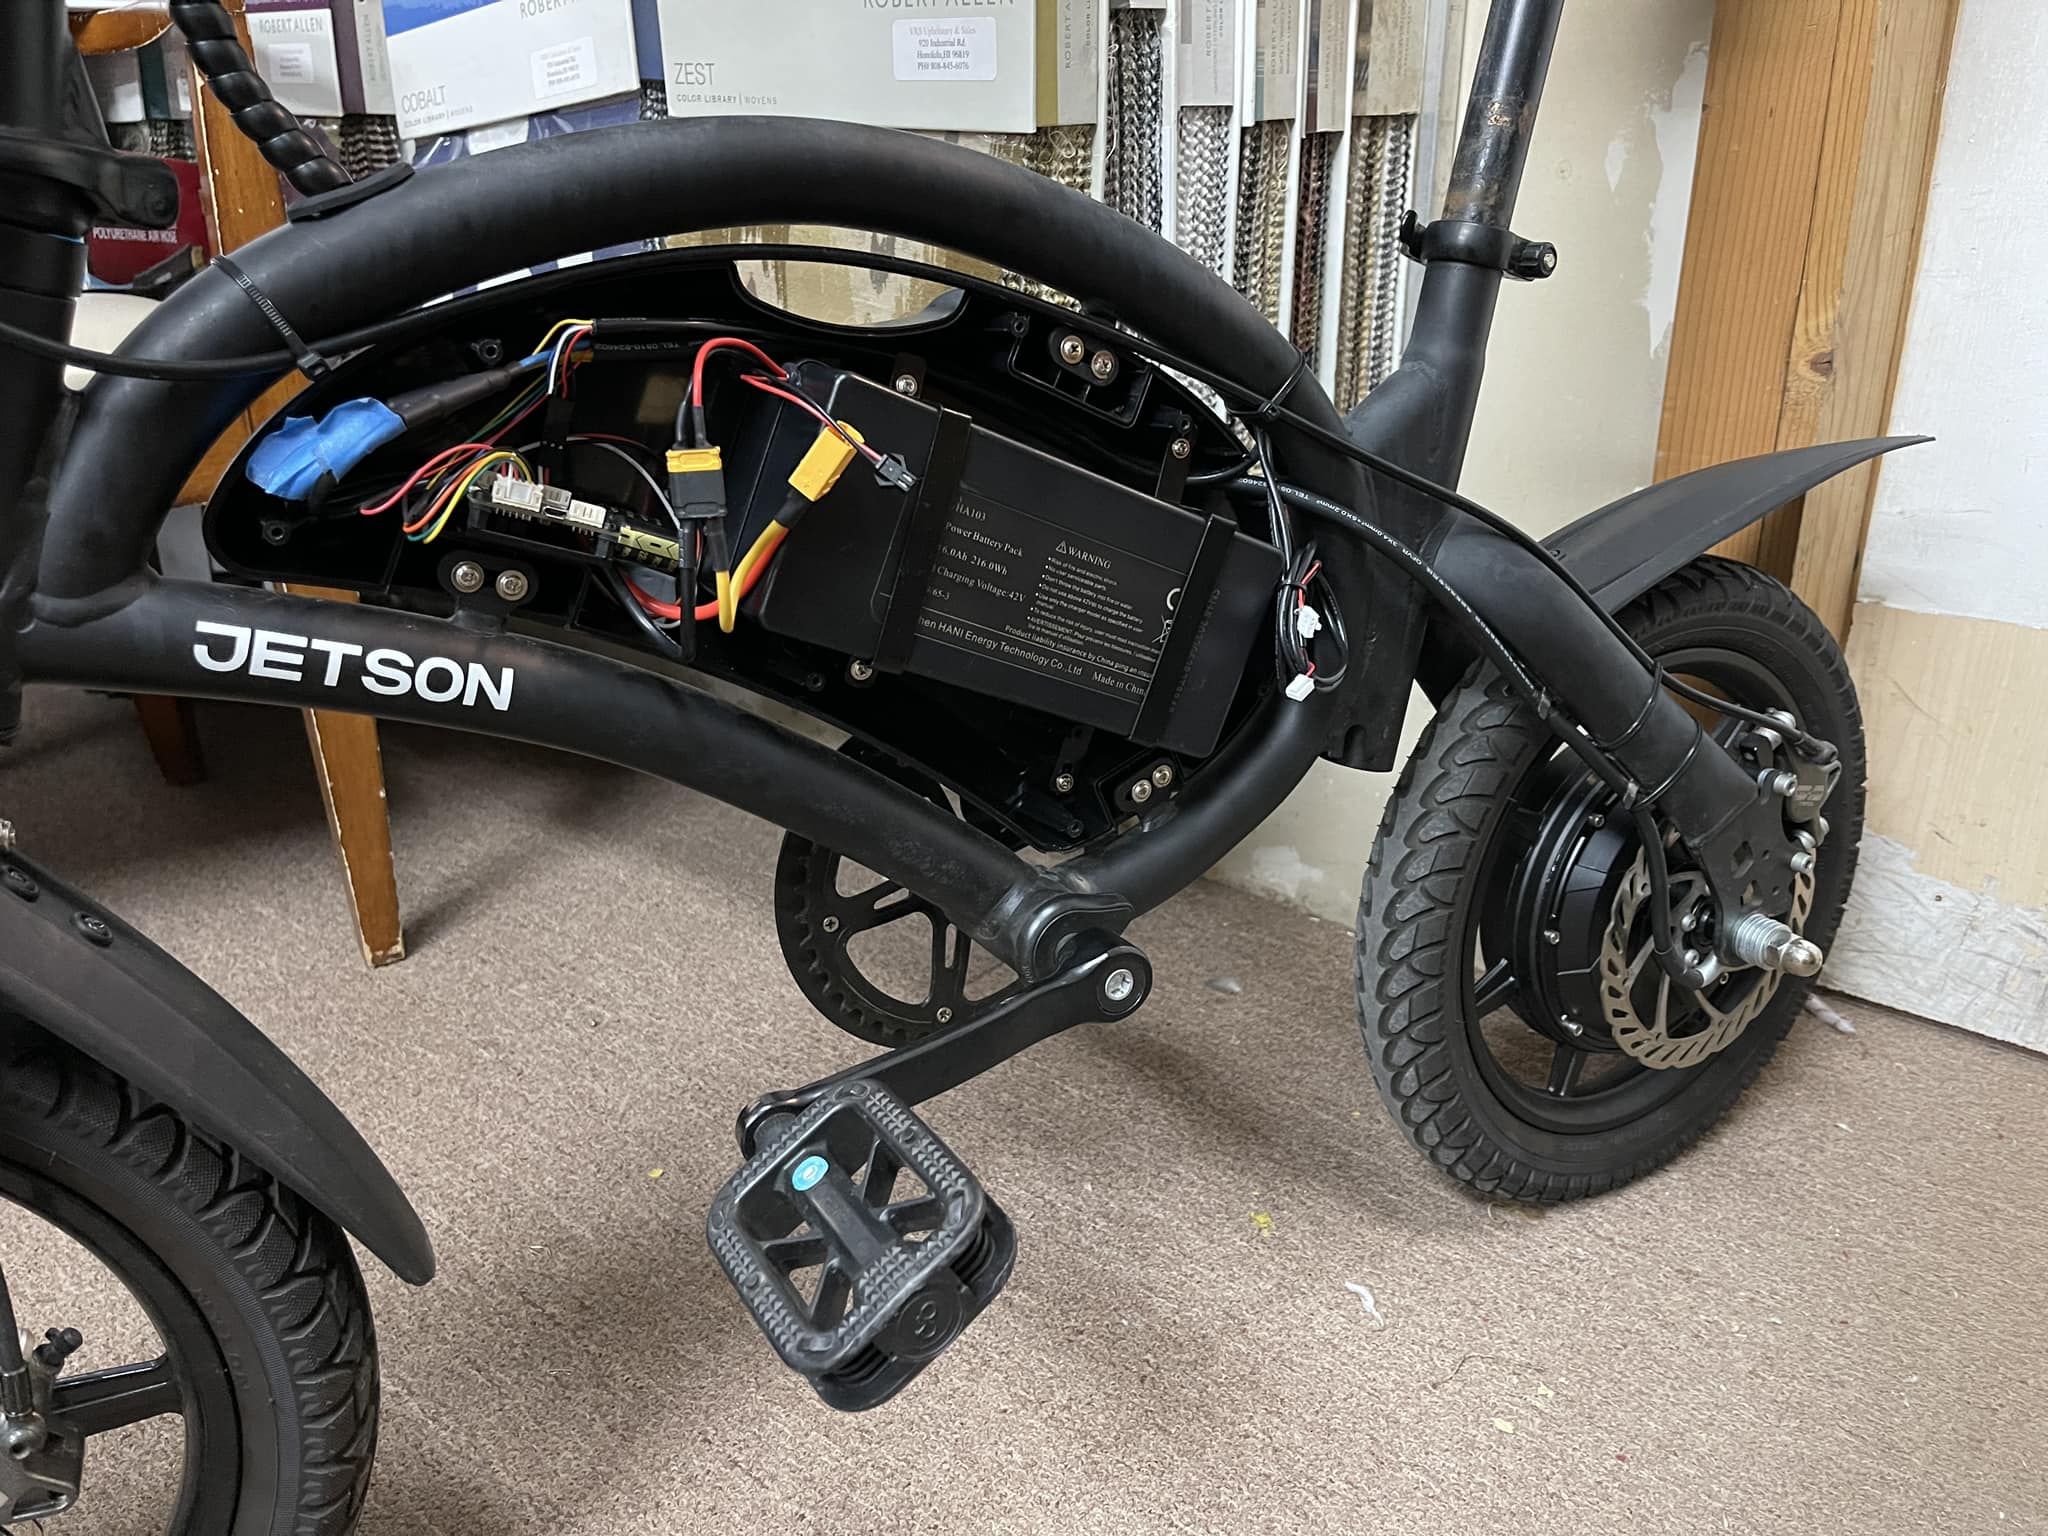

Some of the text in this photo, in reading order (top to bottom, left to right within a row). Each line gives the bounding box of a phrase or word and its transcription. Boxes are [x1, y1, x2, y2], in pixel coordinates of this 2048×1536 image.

[1063, 15, 1072, 70] ROBERT
[673, 62, 715, 86] ZEST
[401, 85, 446, 114] COBALT
[676, 93, 702, 103] COLOR
[704, 94, 737, 104] LIBRARY
[93, 226, 147, 241] POLYURETHANE
[148, 229, 161, 243] AIR
[945, 520, 1023, 557] Power Battery Pack
[970, 555, 1008, 576] 216.0Wh
[1068, 546, 1112, 569] WARNING
[937, 565, 975, 588] Charging
[938, 621, 964, 638] HANI
[965, 630, 998, 650] Energy
[999, 641, 1050, 667] Technology
[1092, 672, 1115, 687] Made
[1115, 680, 1124, 689] in
[1004, 624, 1032, 640] Product
[1056, 642, 1087, 658] insurance
[1087, 652, 1096, 662] by
[1096, 655, 1114, 667] China
[193, 620, 515, 711] JETSON
